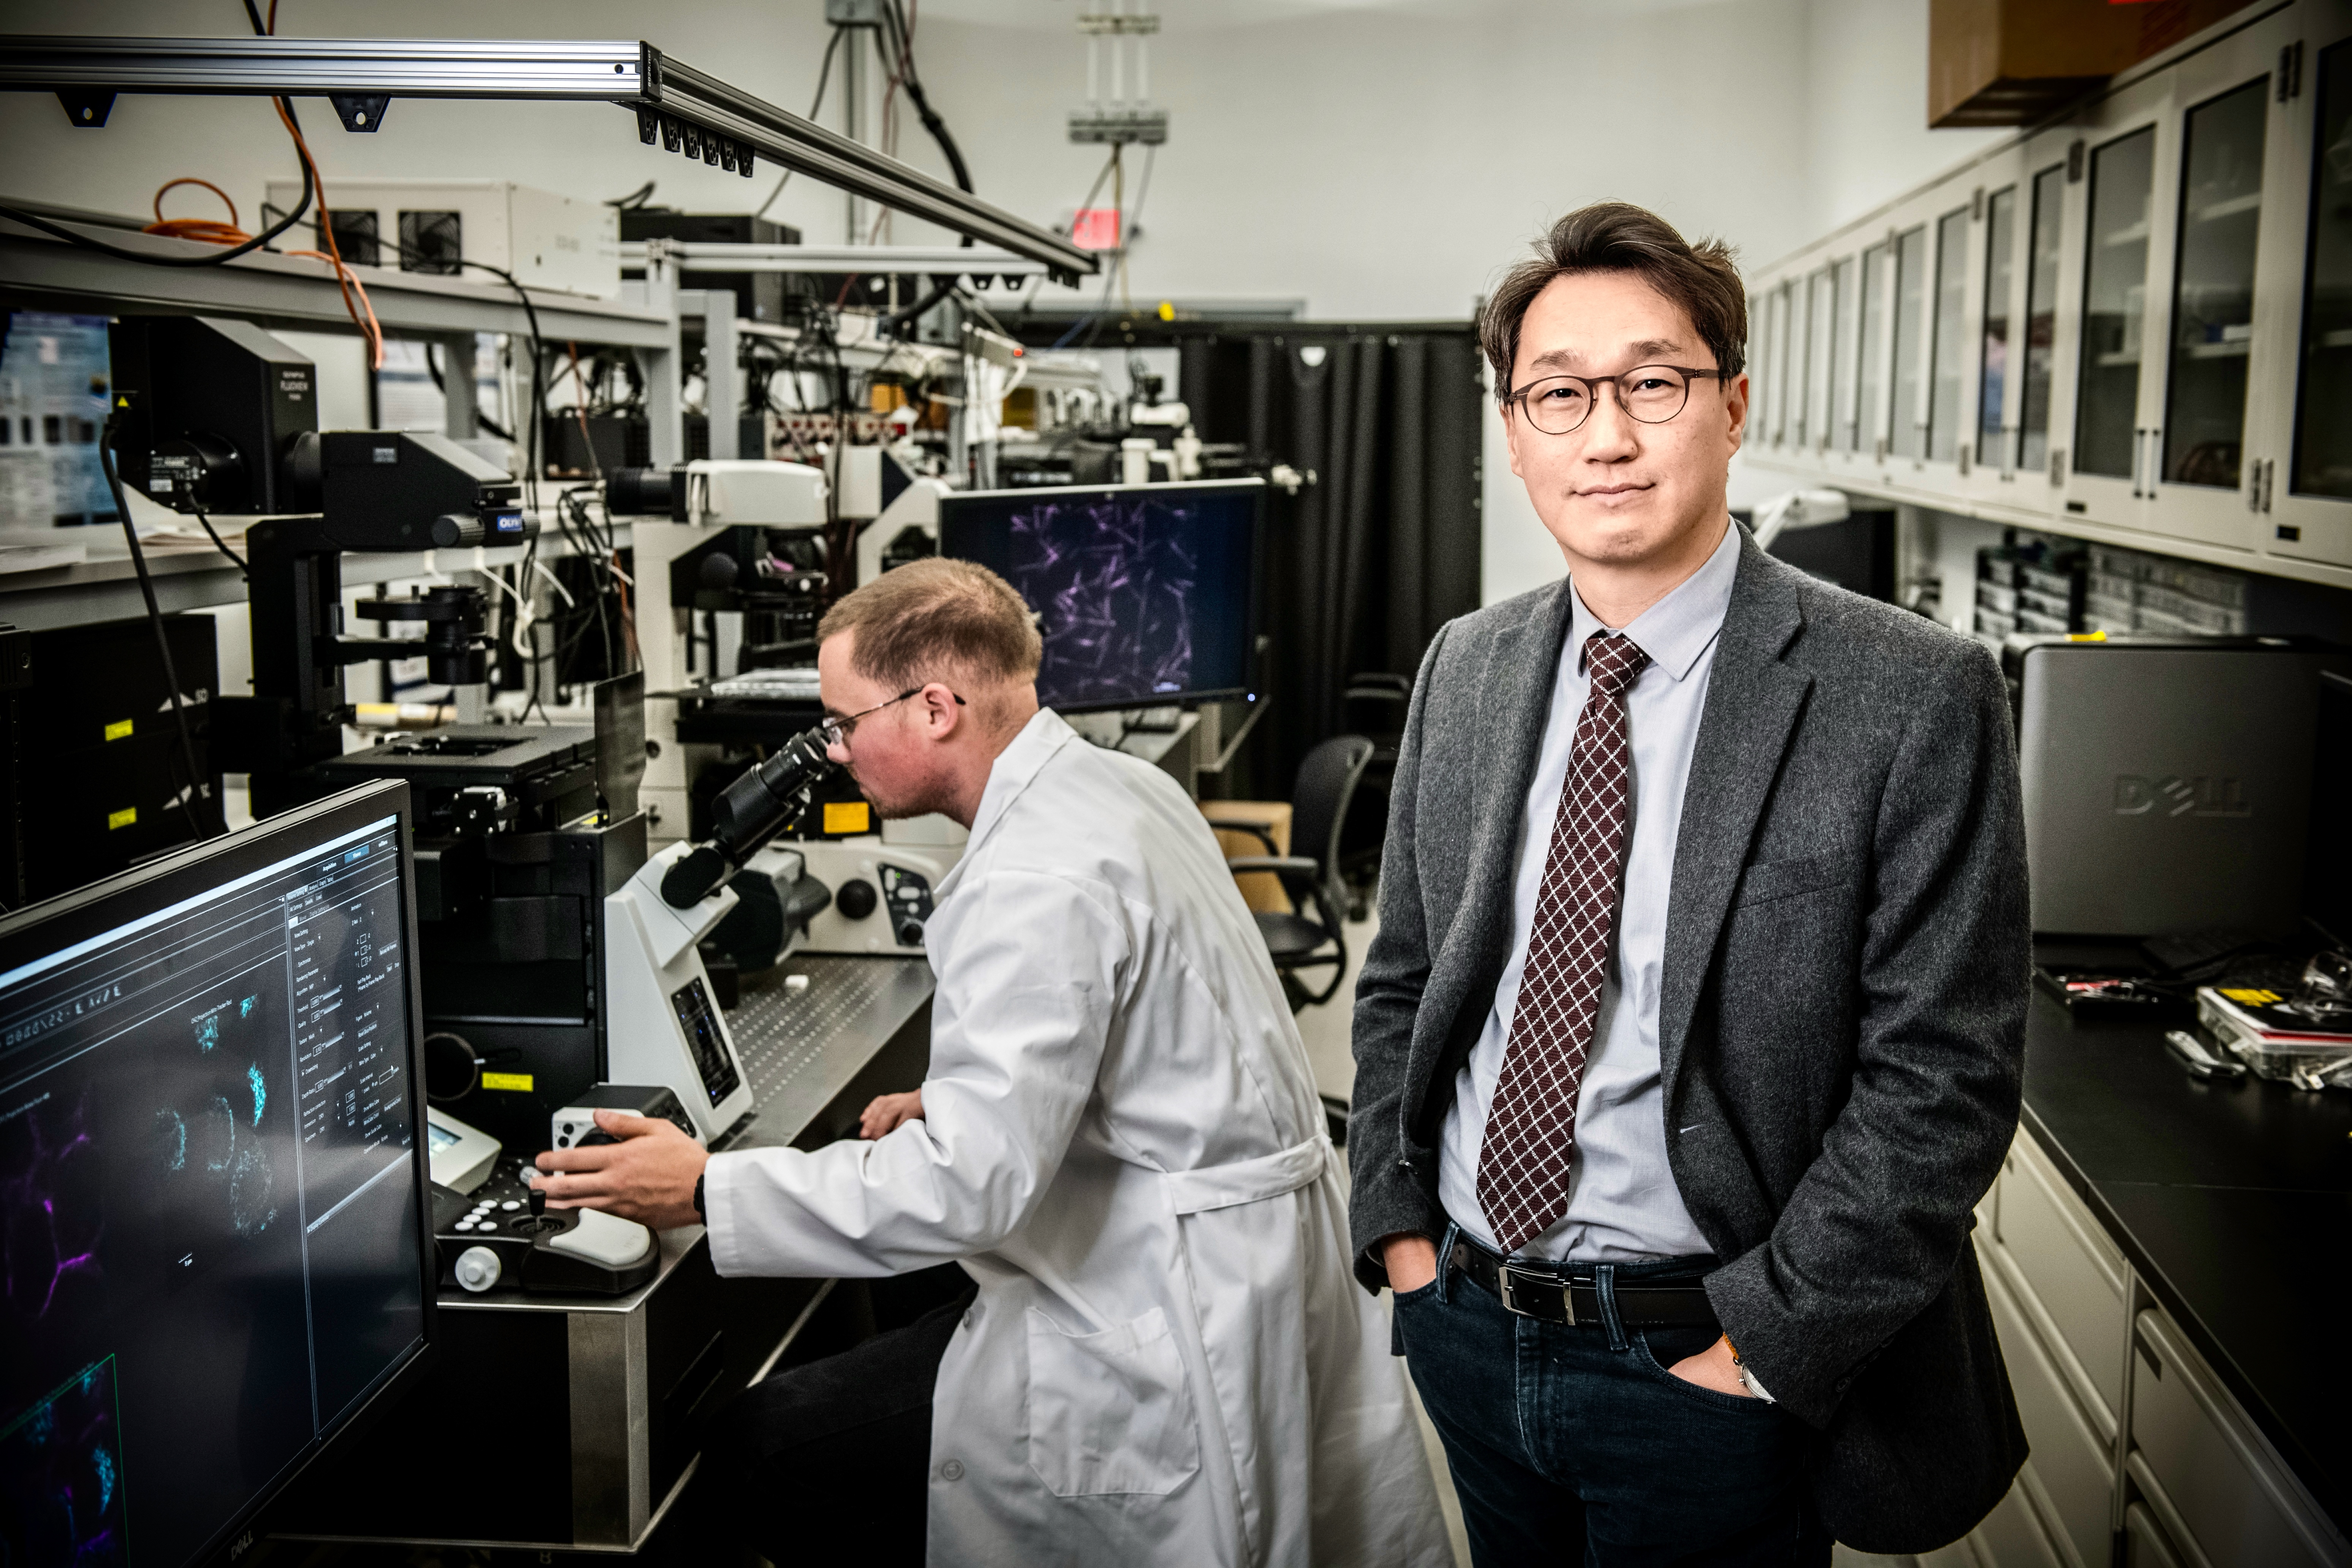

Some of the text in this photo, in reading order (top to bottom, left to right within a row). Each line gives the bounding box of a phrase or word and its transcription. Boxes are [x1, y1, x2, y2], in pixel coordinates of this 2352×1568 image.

[2114, 774, 2251, 817] DELL
[323, 862, 337, 871] Acquisition
[300, 1053, 312, 1062] Resolution
[304, 1119, 316, 1129] Immersion
[305, 1132, 316, 1143] Specimen
[231, 1530, 253, 1562] DELL
